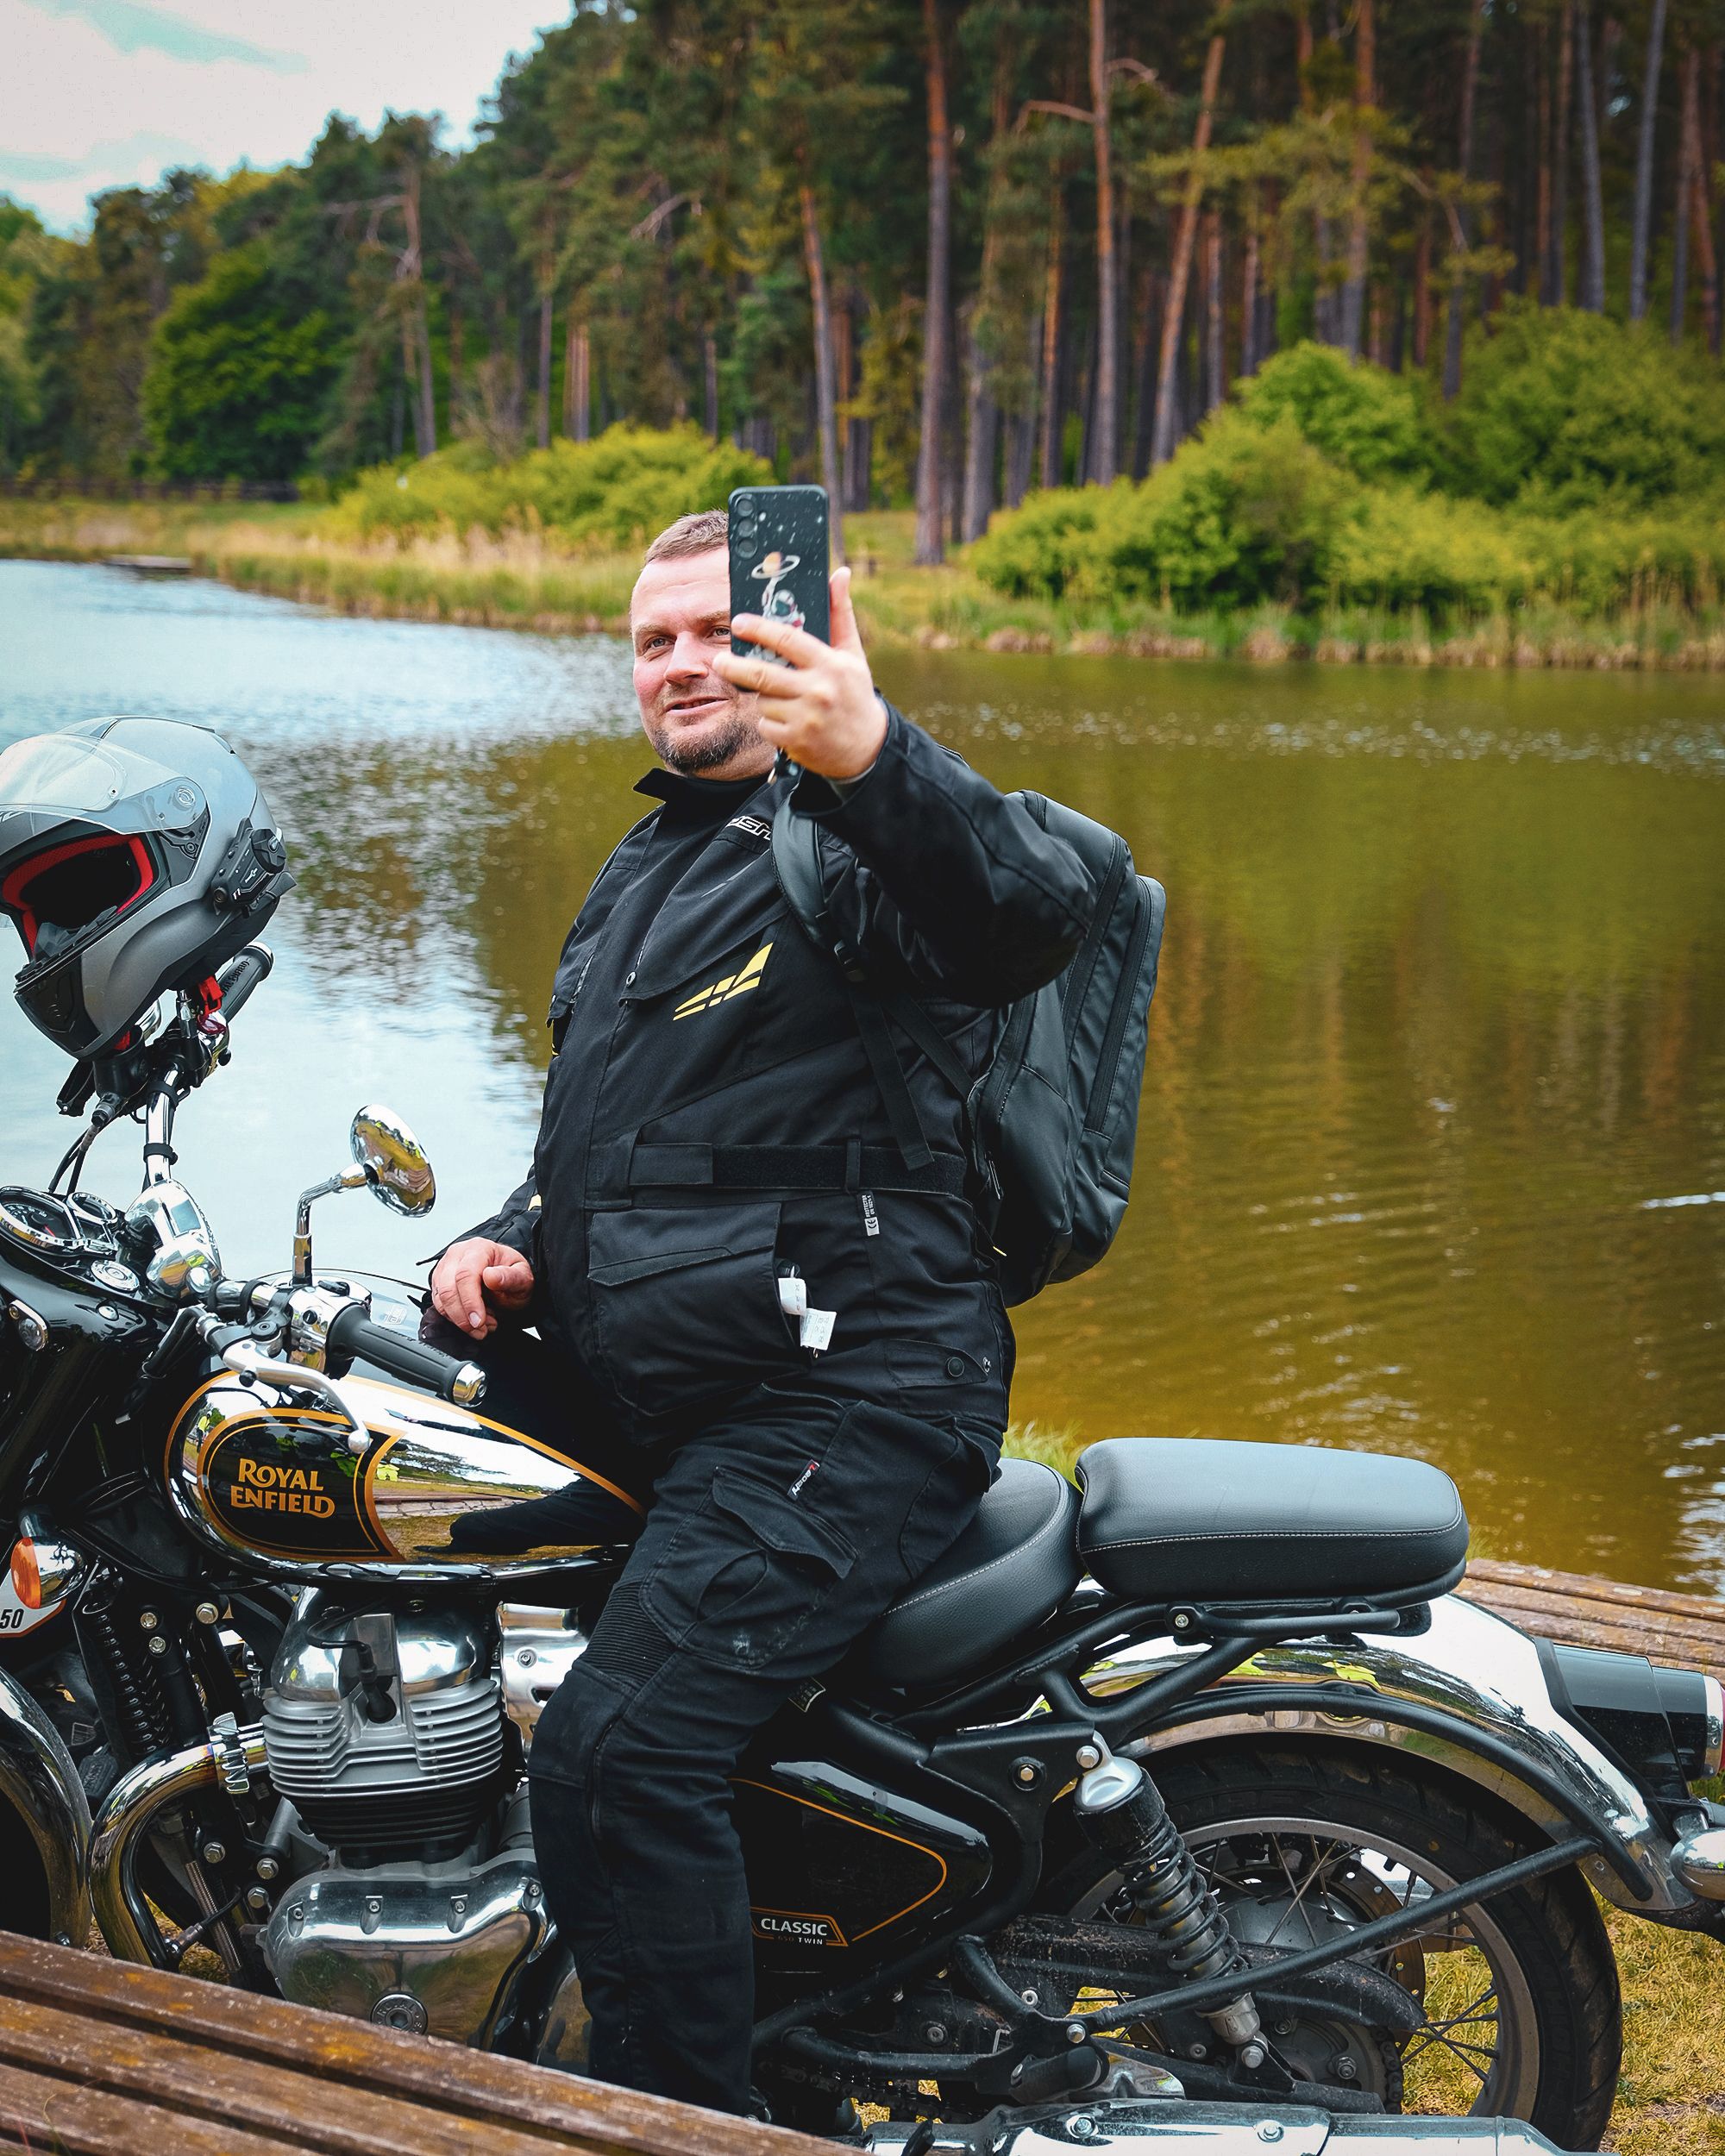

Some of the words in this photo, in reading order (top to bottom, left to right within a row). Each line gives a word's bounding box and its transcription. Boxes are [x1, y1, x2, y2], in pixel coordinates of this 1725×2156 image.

[238, 1457, 324, 1491] ROYAL
[230, 1484, 336, 1519] ENFIELD
[761, 1918, 828, 1936] CLASSIC
